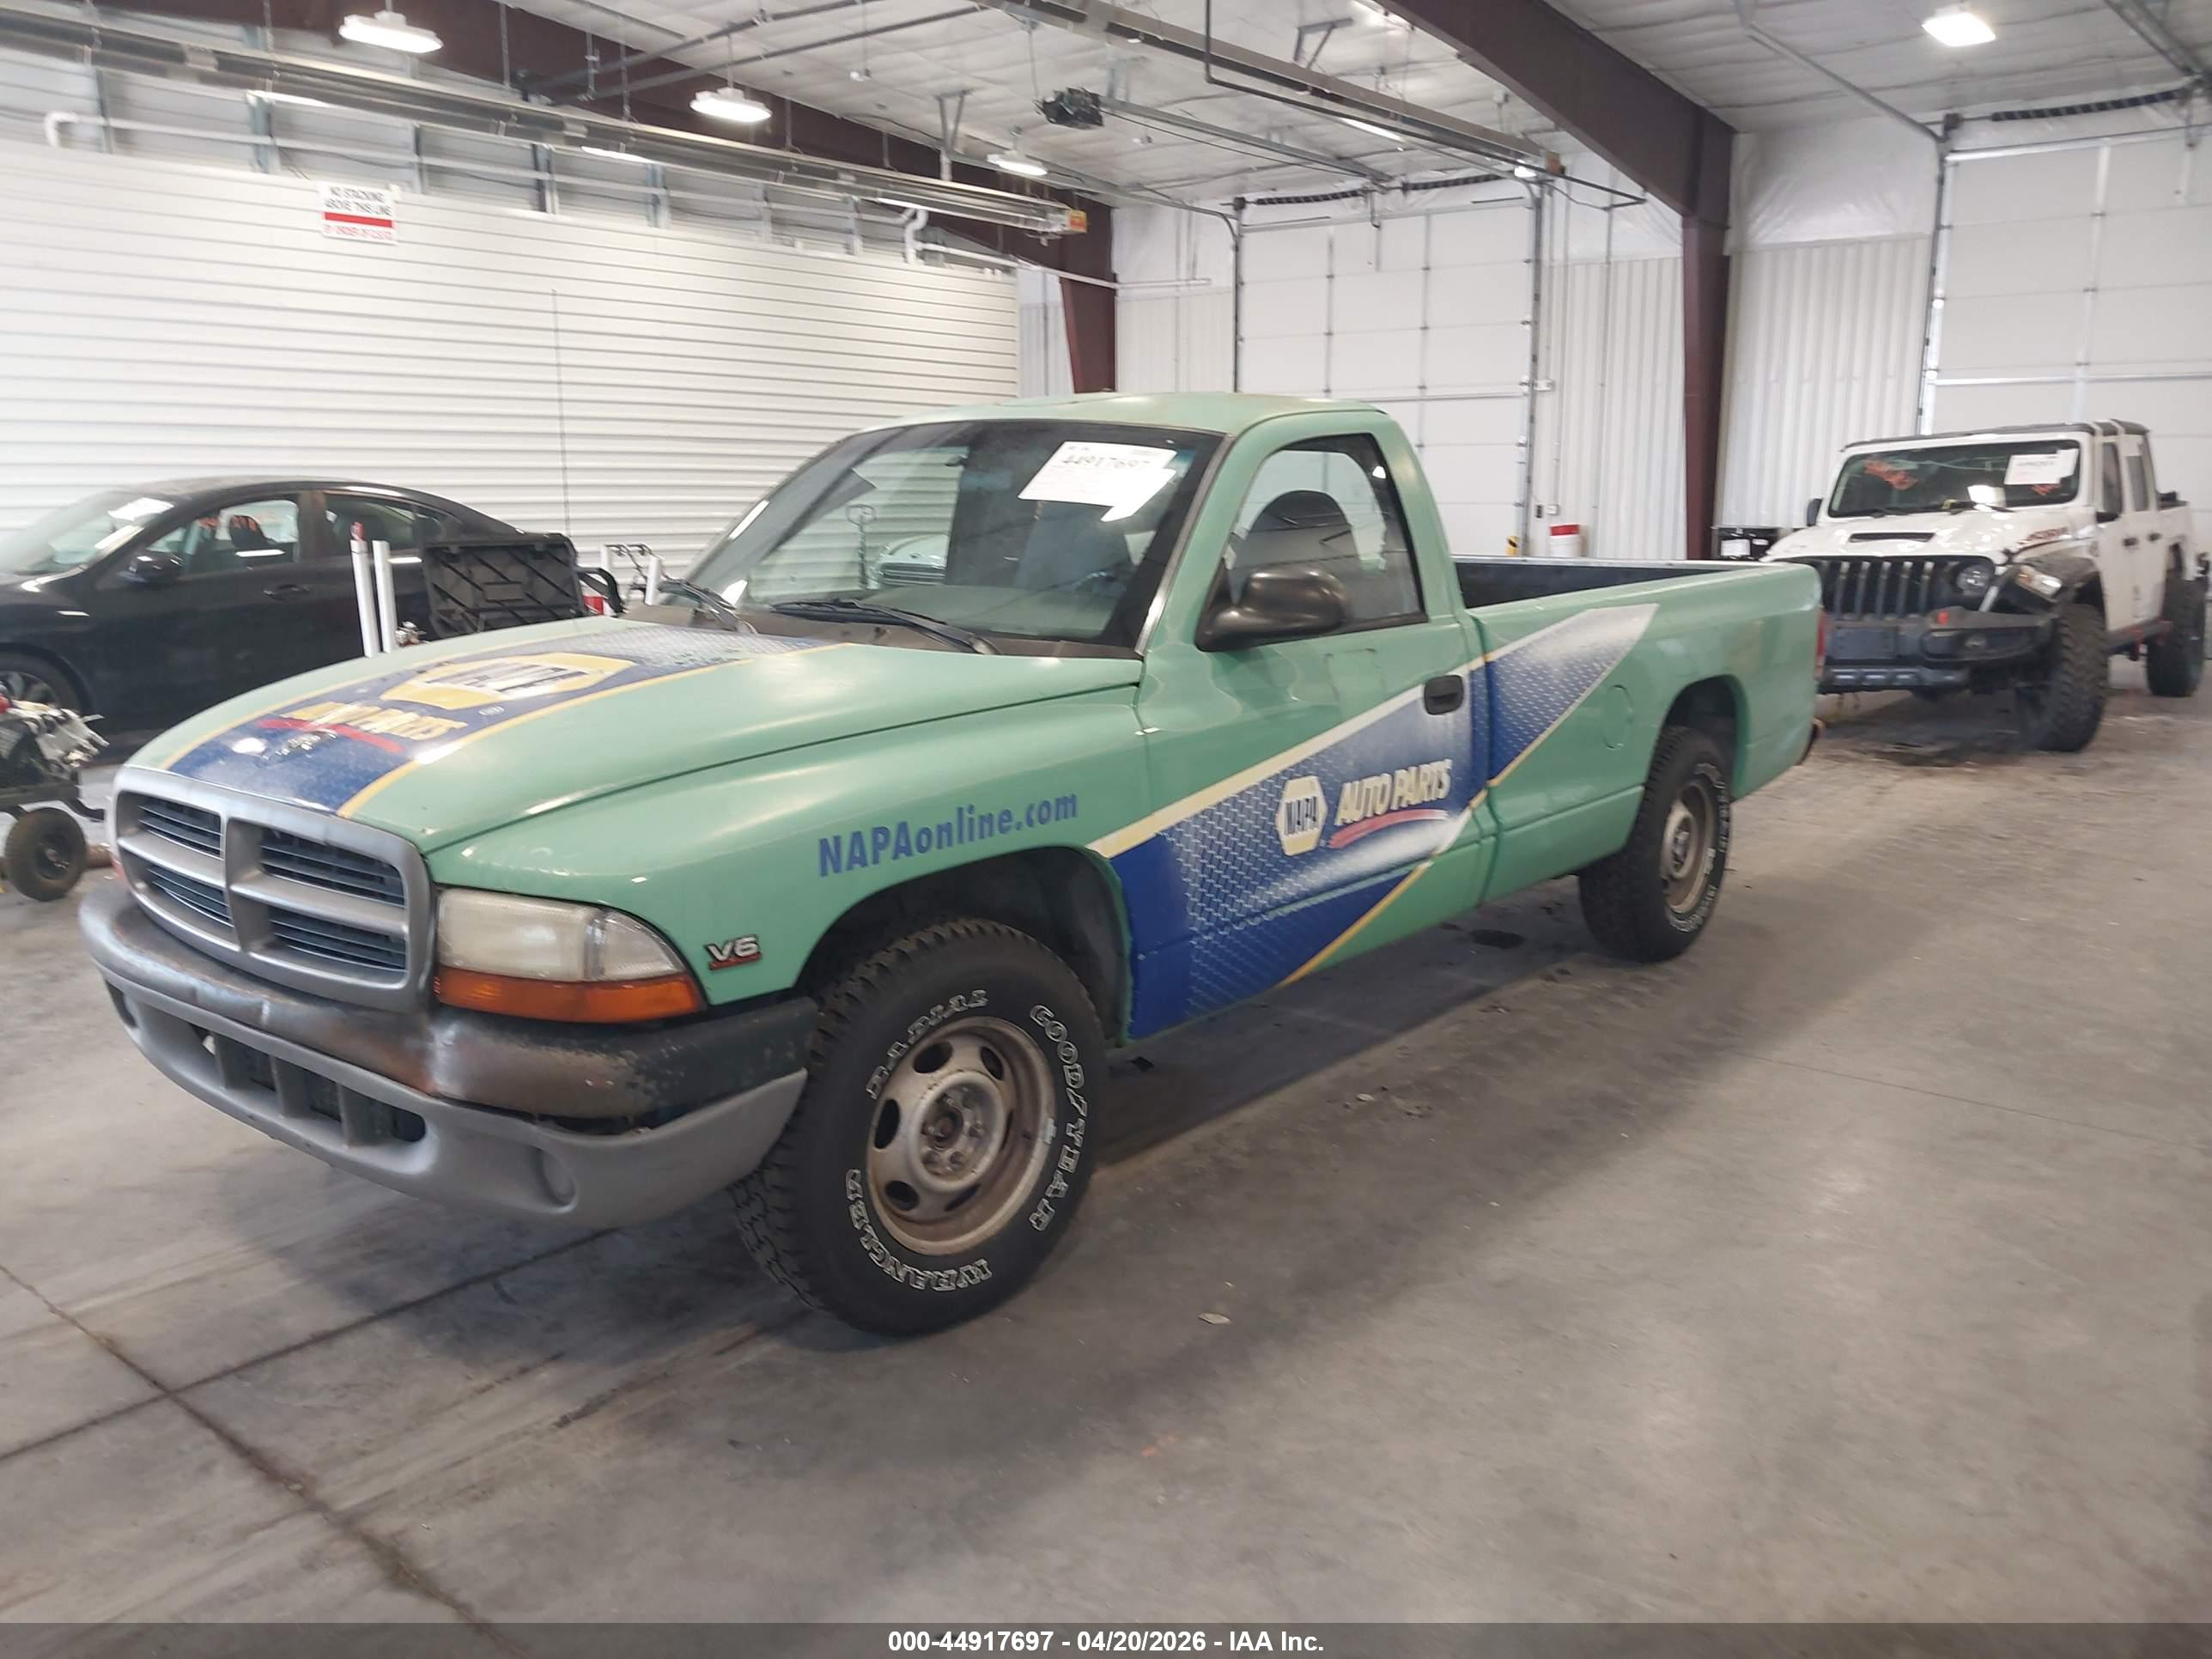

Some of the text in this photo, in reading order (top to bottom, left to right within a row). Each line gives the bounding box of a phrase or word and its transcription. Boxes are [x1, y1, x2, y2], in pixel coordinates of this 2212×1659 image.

[1334, 759, 1454, 826] AUTO PARTS
[818, 793, 1079, 878] NAPAonline.com
[705, 934, 759, 962] V6
[845, 1168, 993, 1291] WRANGLER
